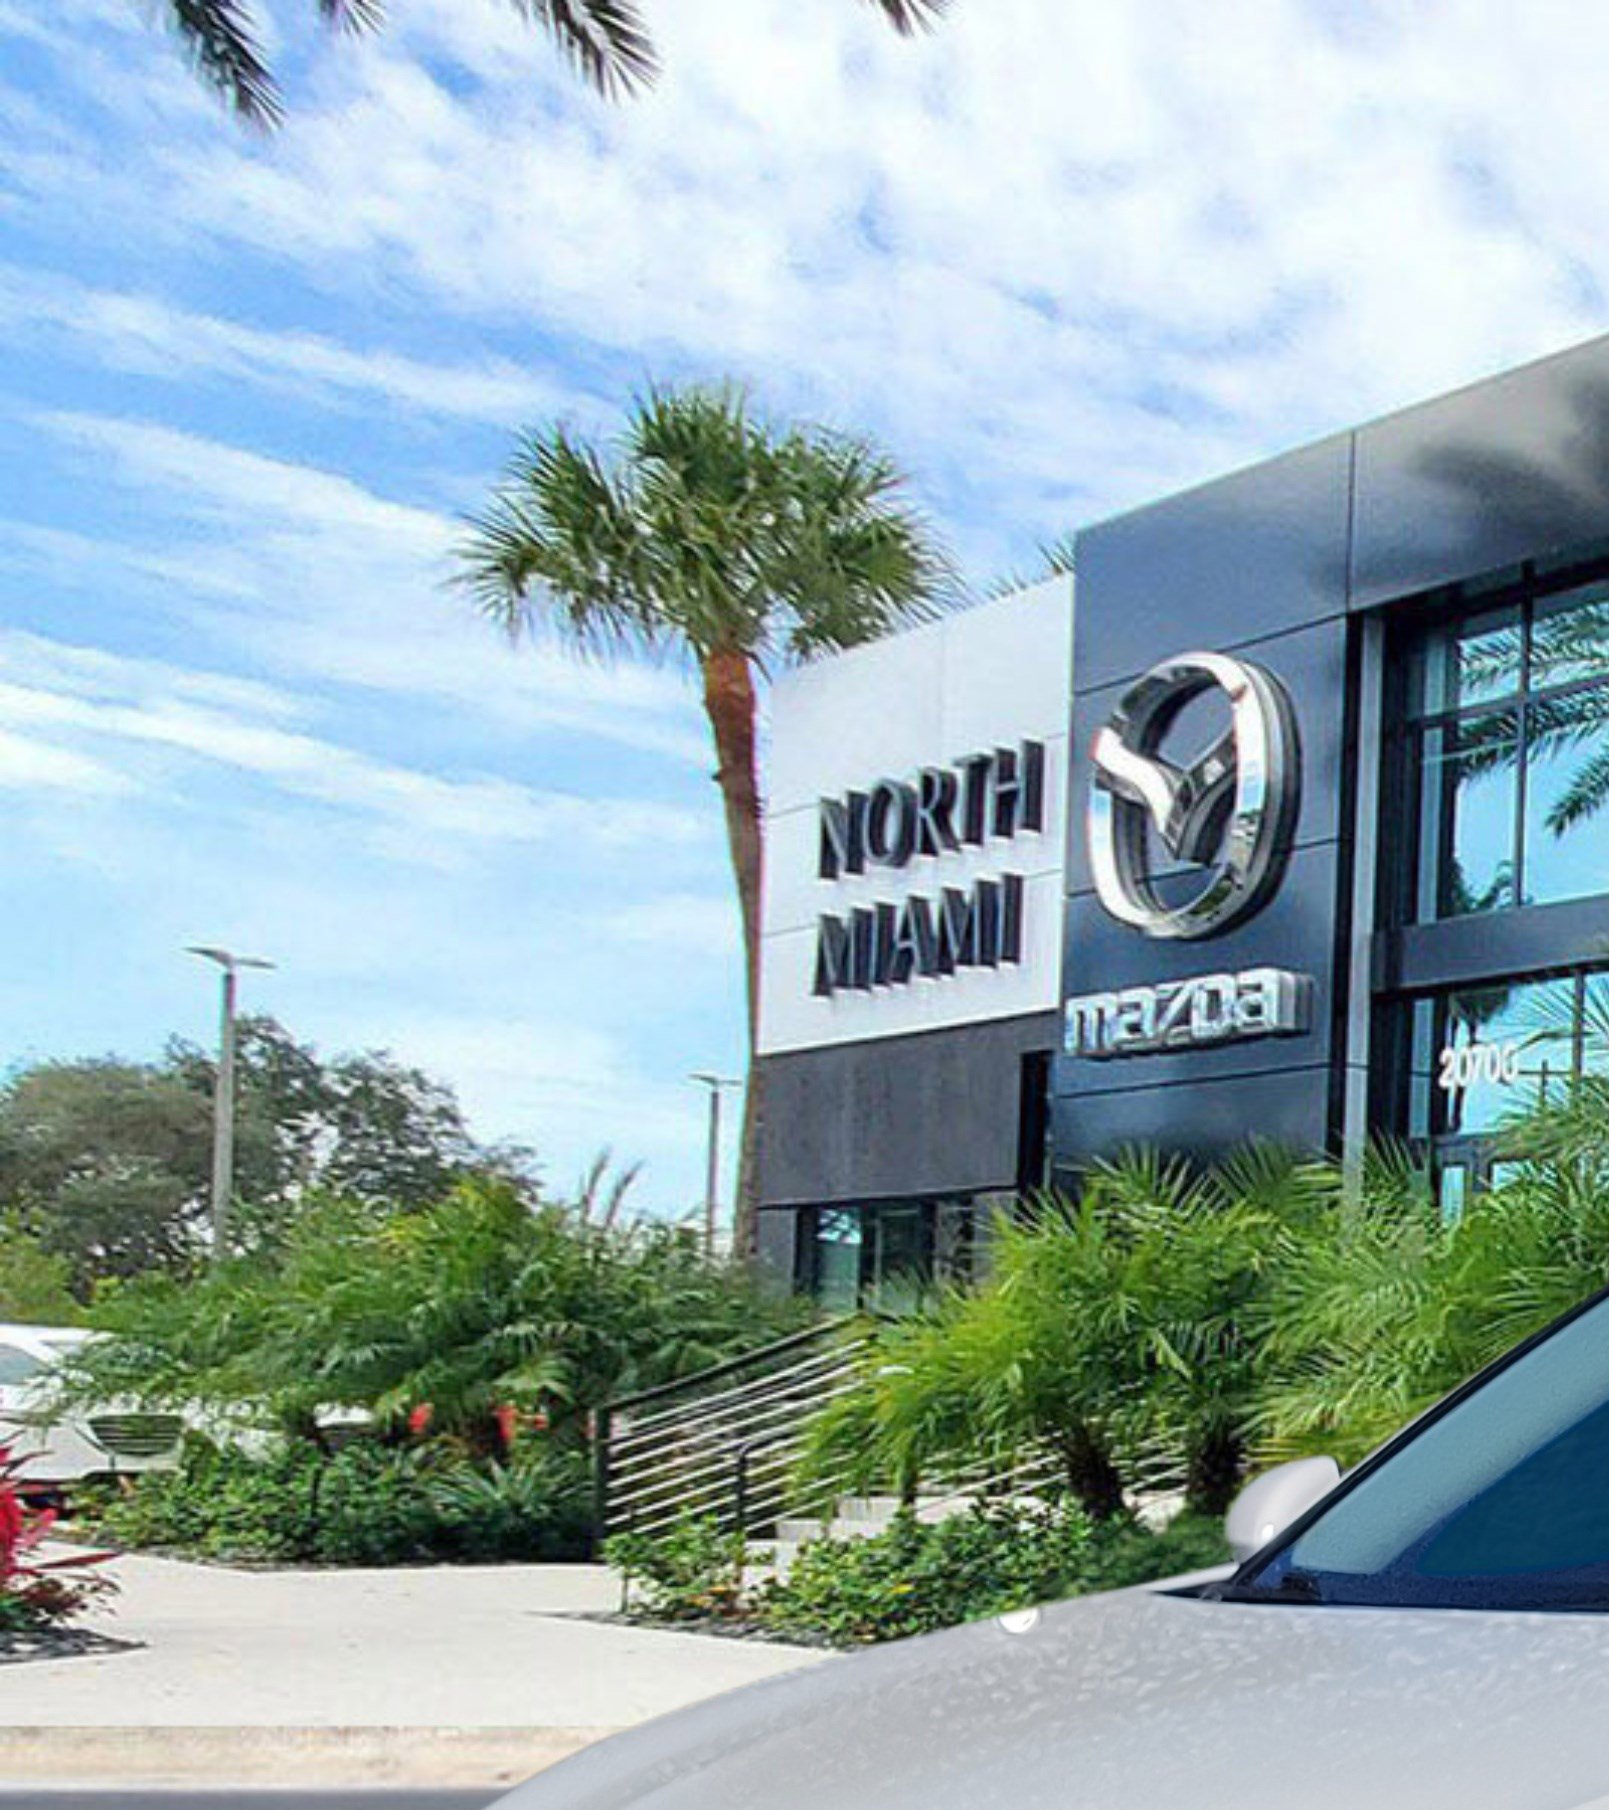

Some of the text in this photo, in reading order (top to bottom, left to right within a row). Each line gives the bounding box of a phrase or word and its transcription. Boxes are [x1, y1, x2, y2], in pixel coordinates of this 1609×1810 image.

[818, 739, 1045, 881] NORTH
[812, 873, 1023, 997] MIAMI
[1063, 967, 1310, 1057] mazda
[1438, 1040, 1519, 1089] 20700
